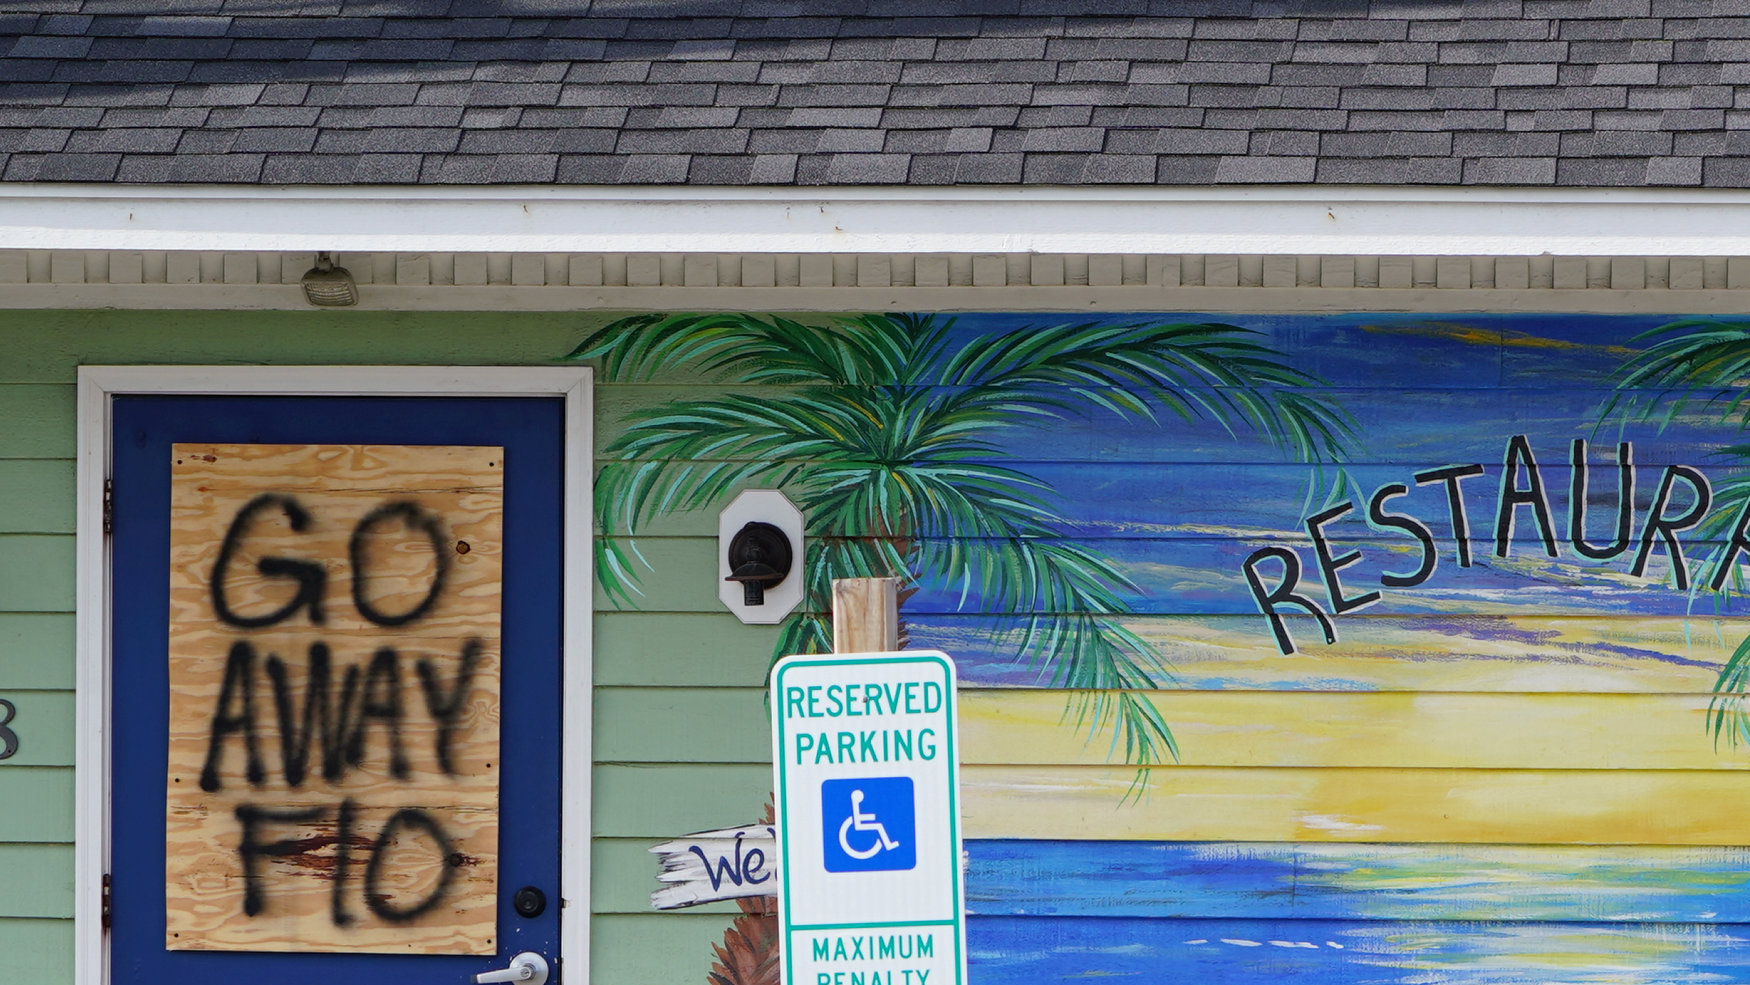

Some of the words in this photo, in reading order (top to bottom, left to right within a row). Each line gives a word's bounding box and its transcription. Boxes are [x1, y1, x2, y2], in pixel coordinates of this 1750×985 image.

[210, 492, 453, 629] GO
[199, 638, 484, 793] AWAY
[786, 681, 942, 719] RESERVED
[796, 728, 936, 765] PARKING
[812, 934, 934, 962] MAXIMUM
